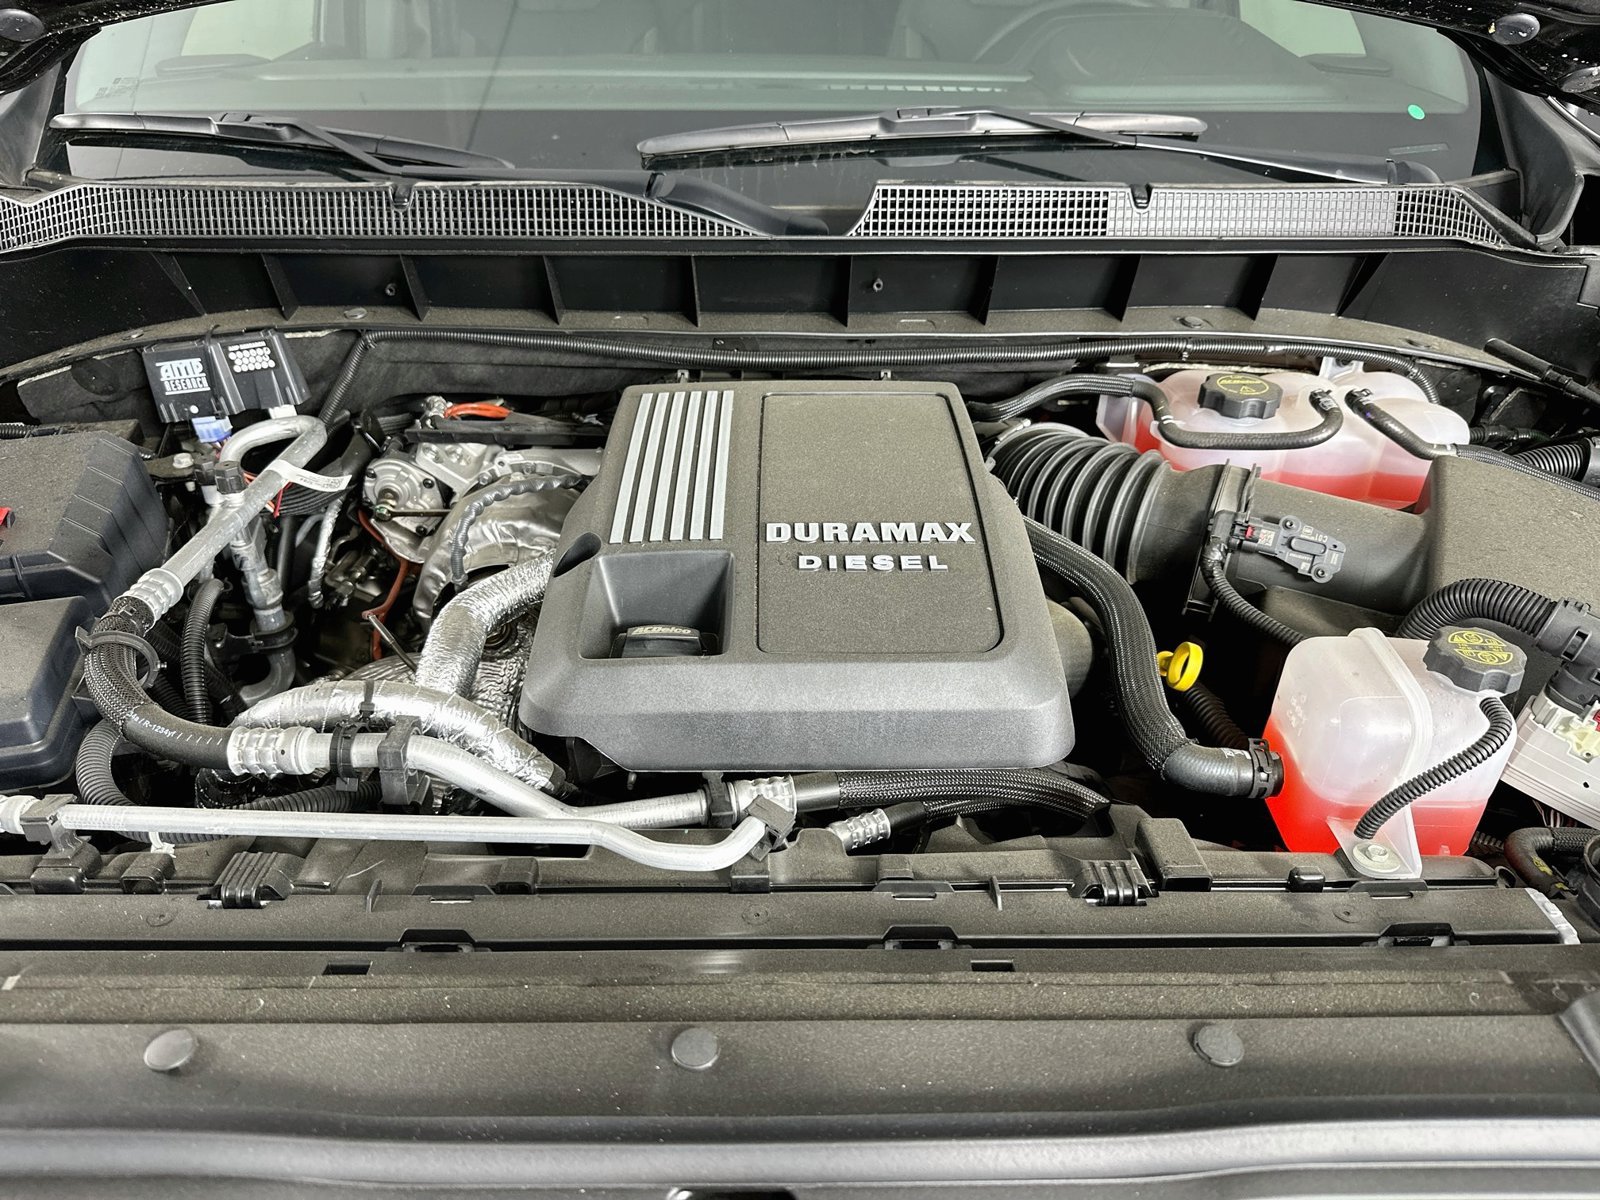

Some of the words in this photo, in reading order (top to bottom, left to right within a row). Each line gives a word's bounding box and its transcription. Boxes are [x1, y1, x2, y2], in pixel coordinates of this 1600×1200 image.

[161, 360, 204, 378] AMP
[165, 377, 208, 391] RESEARCH
[766, 522, 976, 543] DURAMAX
[798, 554, 949, 572] DIESEL
